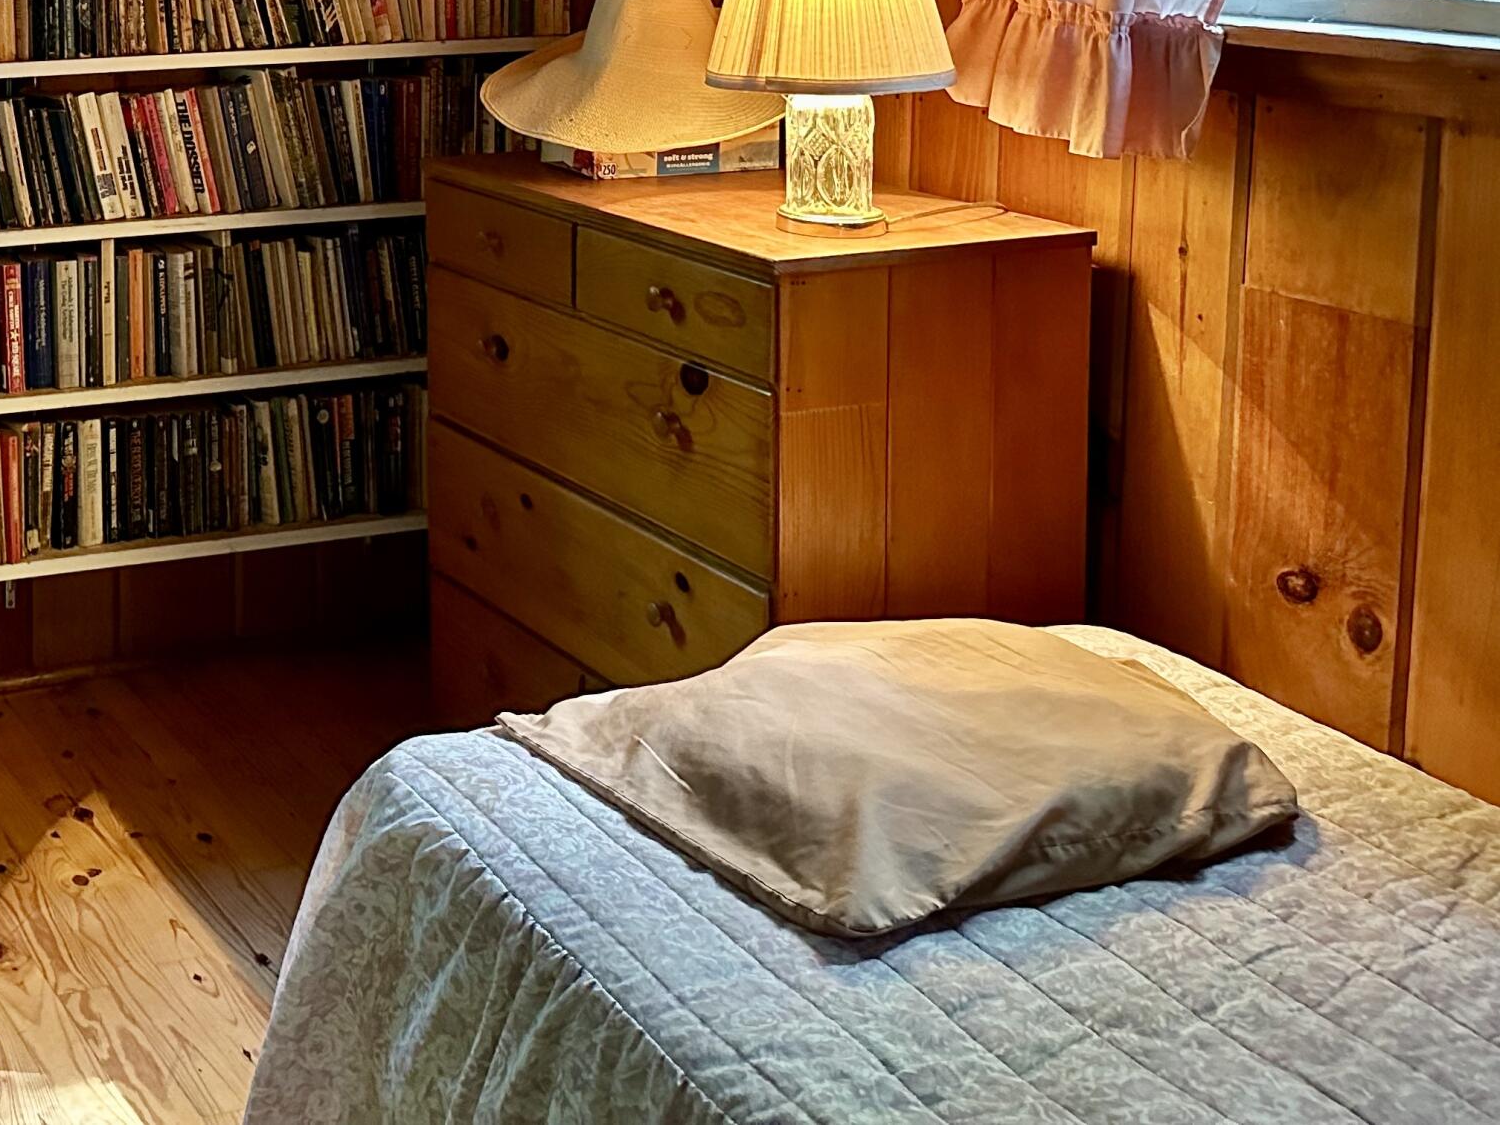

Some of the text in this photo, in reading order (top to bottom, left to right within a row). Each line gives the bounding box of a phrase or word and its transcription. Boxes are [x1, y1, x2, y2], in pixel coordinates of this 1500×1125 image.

[176, 99, 205, 194] THE DOSSIER
[663, 154, 679, 163] soft
[687, 153, 713, 162] strong
[603, 164, 616, 175] 250
[11, 341, 21, 378] RED SQUARE
[43, 433, 53, 492] MARGARET TRUMAN
